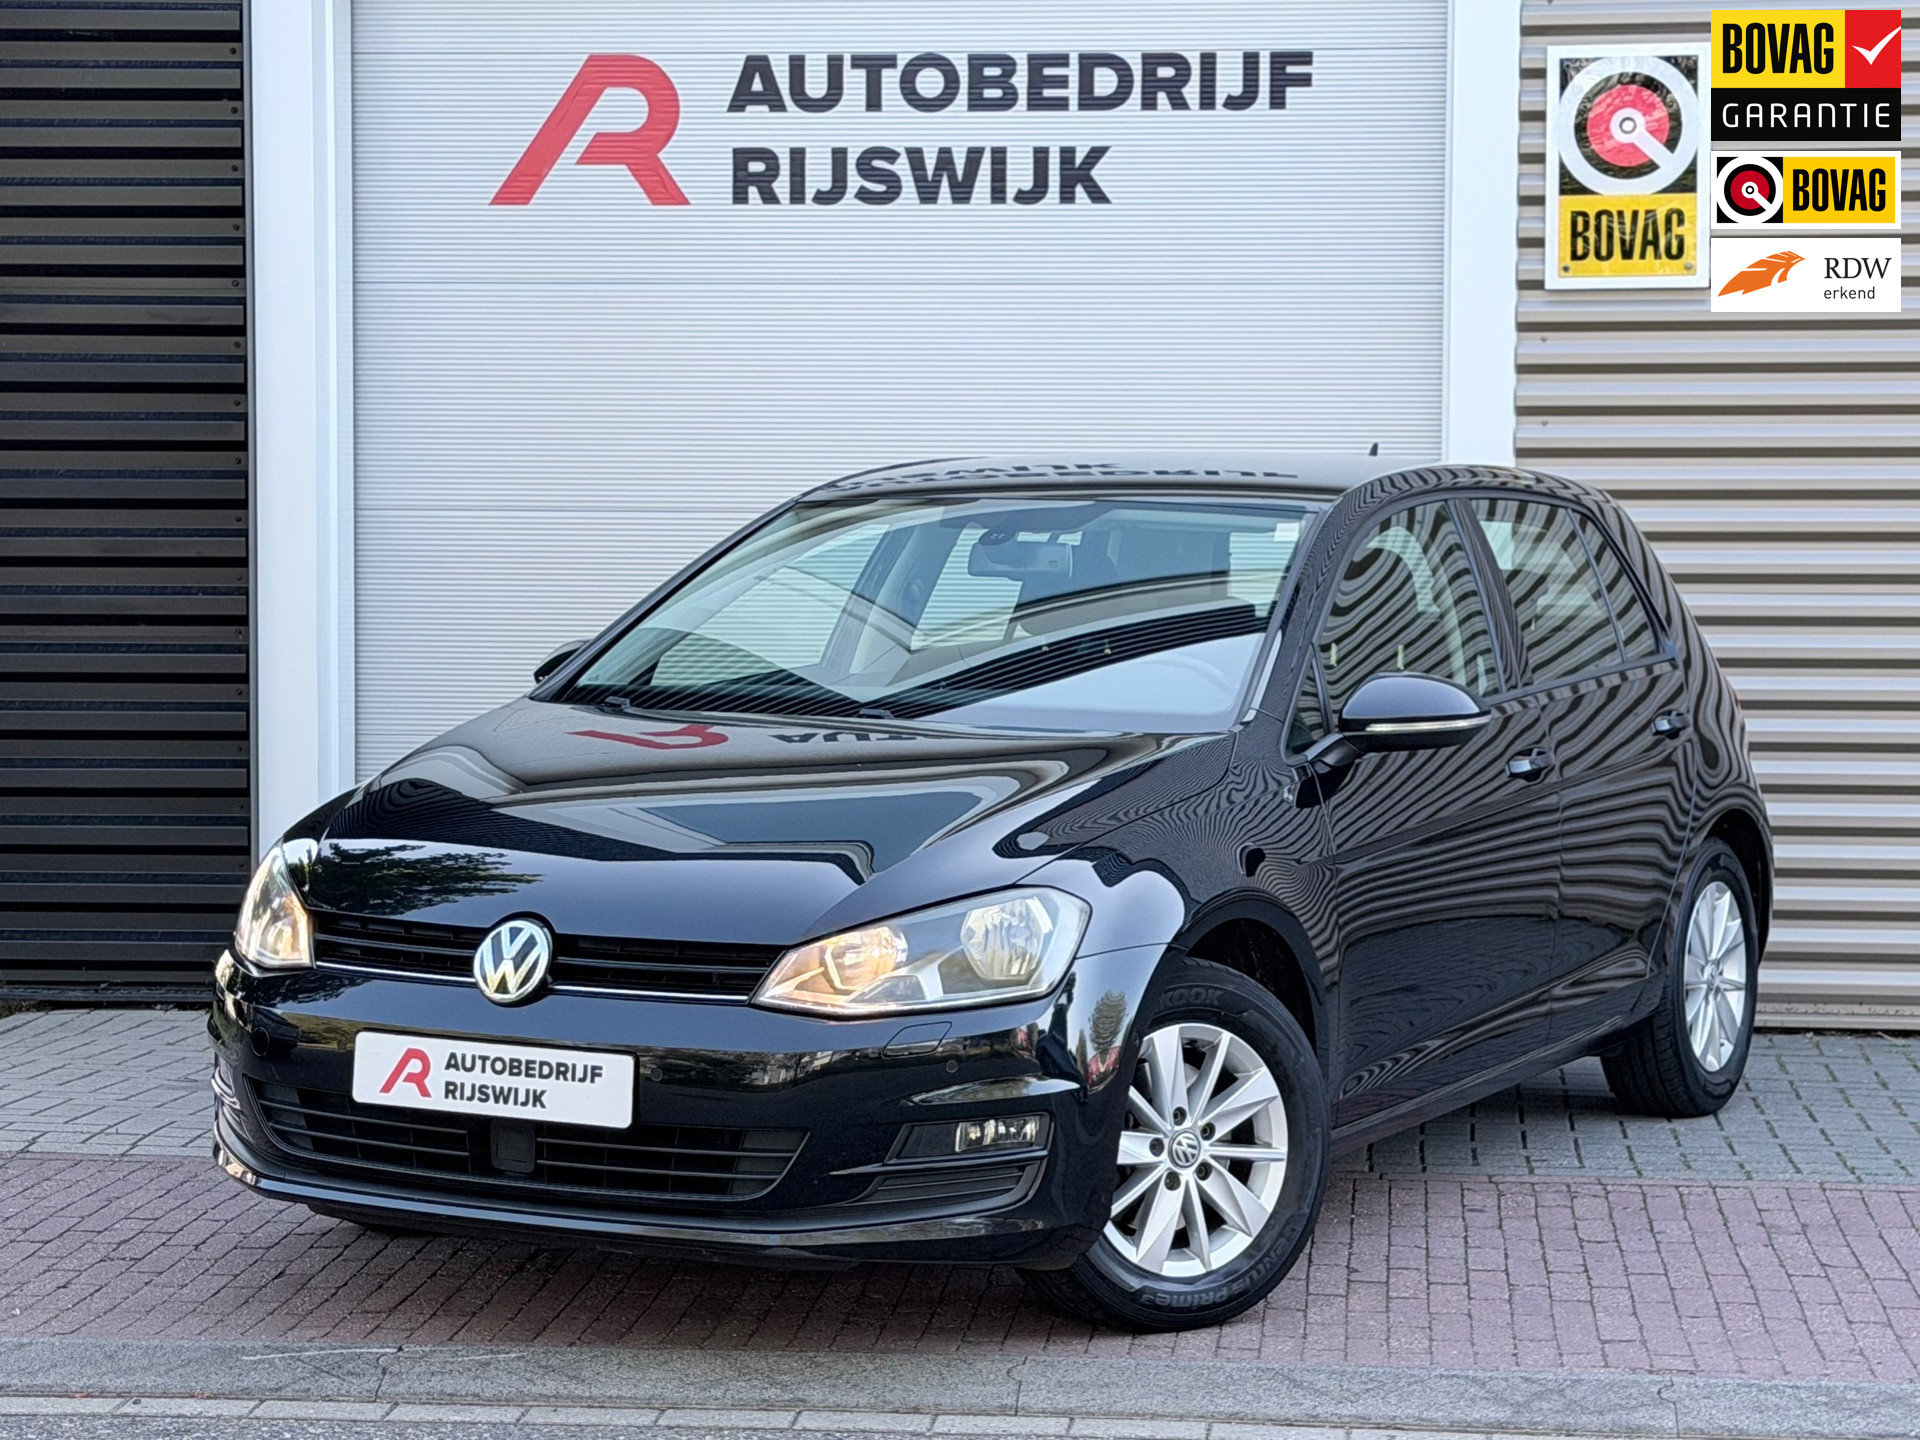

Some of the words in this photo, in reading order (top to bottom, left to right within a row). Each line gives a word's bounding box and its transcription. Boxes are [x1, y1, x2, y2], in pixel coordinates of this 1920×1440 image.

[728, 51, 1313, 112] AUTOBEDRIJF
[732, 147, 1111, 205] RIJSWIJK
[1570, 208, 1685, 261] BOVAG
[444, 1052, 603, 1084] AUTOBEDRIJF
[443, 1081, 548, 1109] RIJSWIJK
